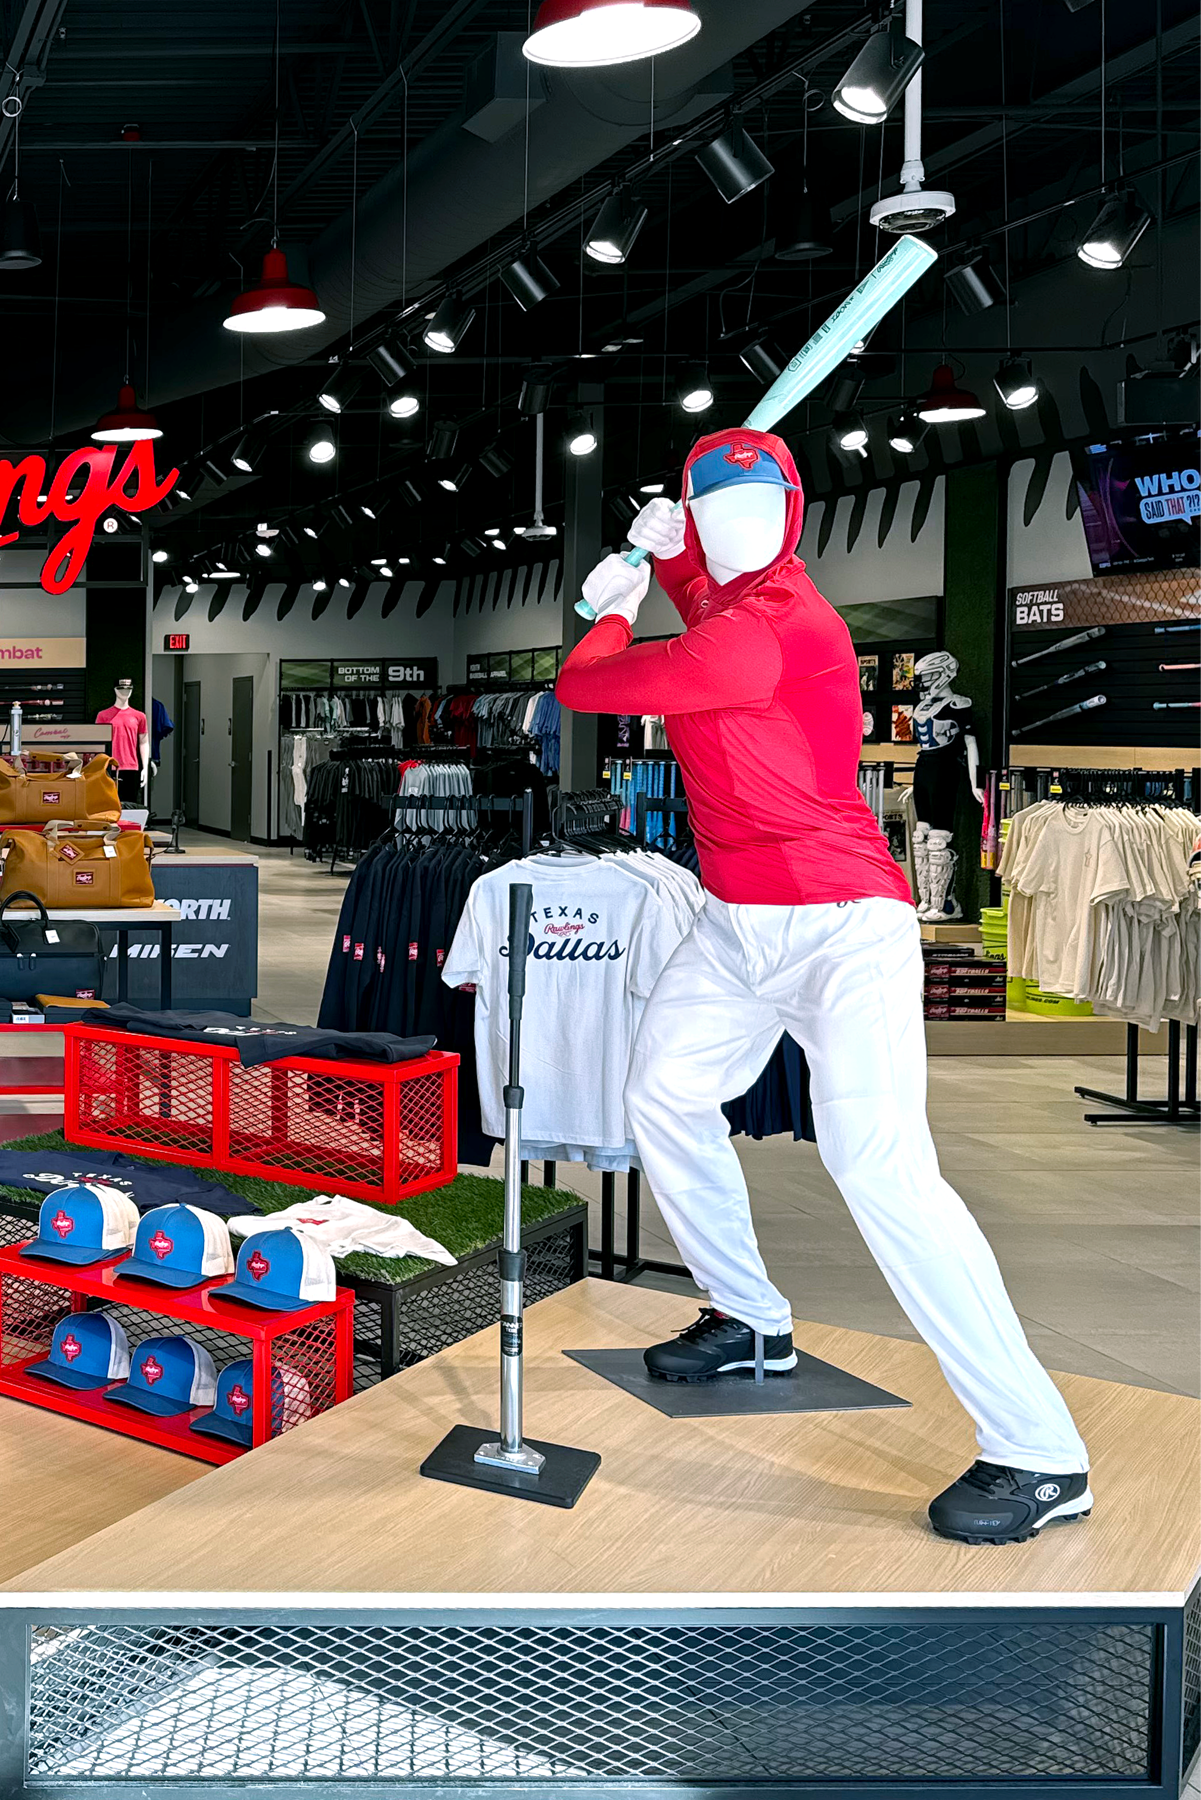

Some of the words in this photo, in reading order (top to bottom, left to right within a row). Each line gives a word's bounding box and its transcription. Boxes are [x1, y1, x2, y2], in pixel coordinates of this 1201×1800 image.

[1135, 469, 1200, 497] WHO
[1144, 500, 1165, 520] SAID
[1165, 497, 1186, 517] THAT
[1015, 589, 1059, 605] SOFTBALL
[1015, 602, 1064, 625] BATS
[169, 634, 187, 649] EXIT
[361, 674, 380, 682] THE
[388, 665, 425, 682] 9th
[154, 898, 229, 920] ORTH
[530, 906, 600, 925] TEXAS
[543, 921, 586, 935] Rawlings
